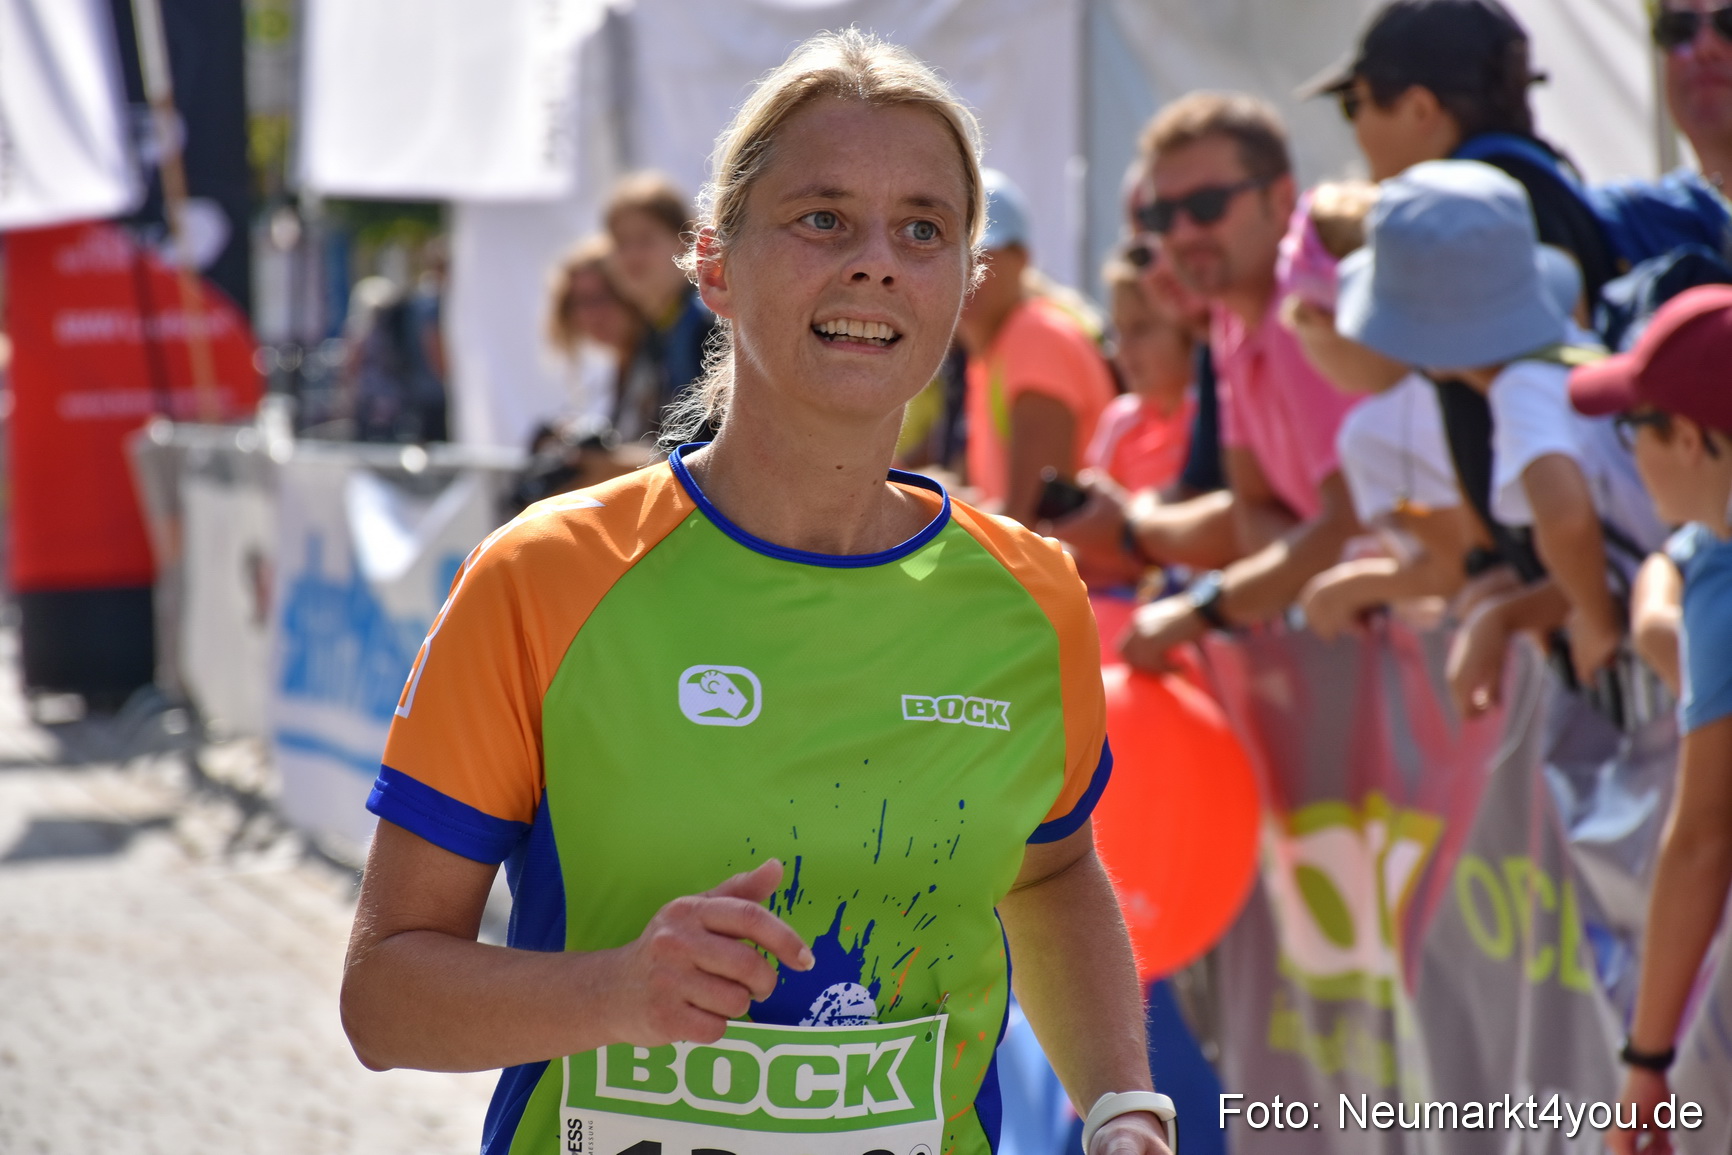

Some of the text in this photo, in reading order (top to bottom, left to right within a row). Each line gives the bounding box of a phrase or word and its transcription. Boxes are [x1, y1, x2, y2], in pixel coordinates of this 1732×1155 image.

[902, 695, 1011, 731] BOCK
[598, 1037, 912, 1117] BOCK
[567, 1117, 583, 1155] ESS
